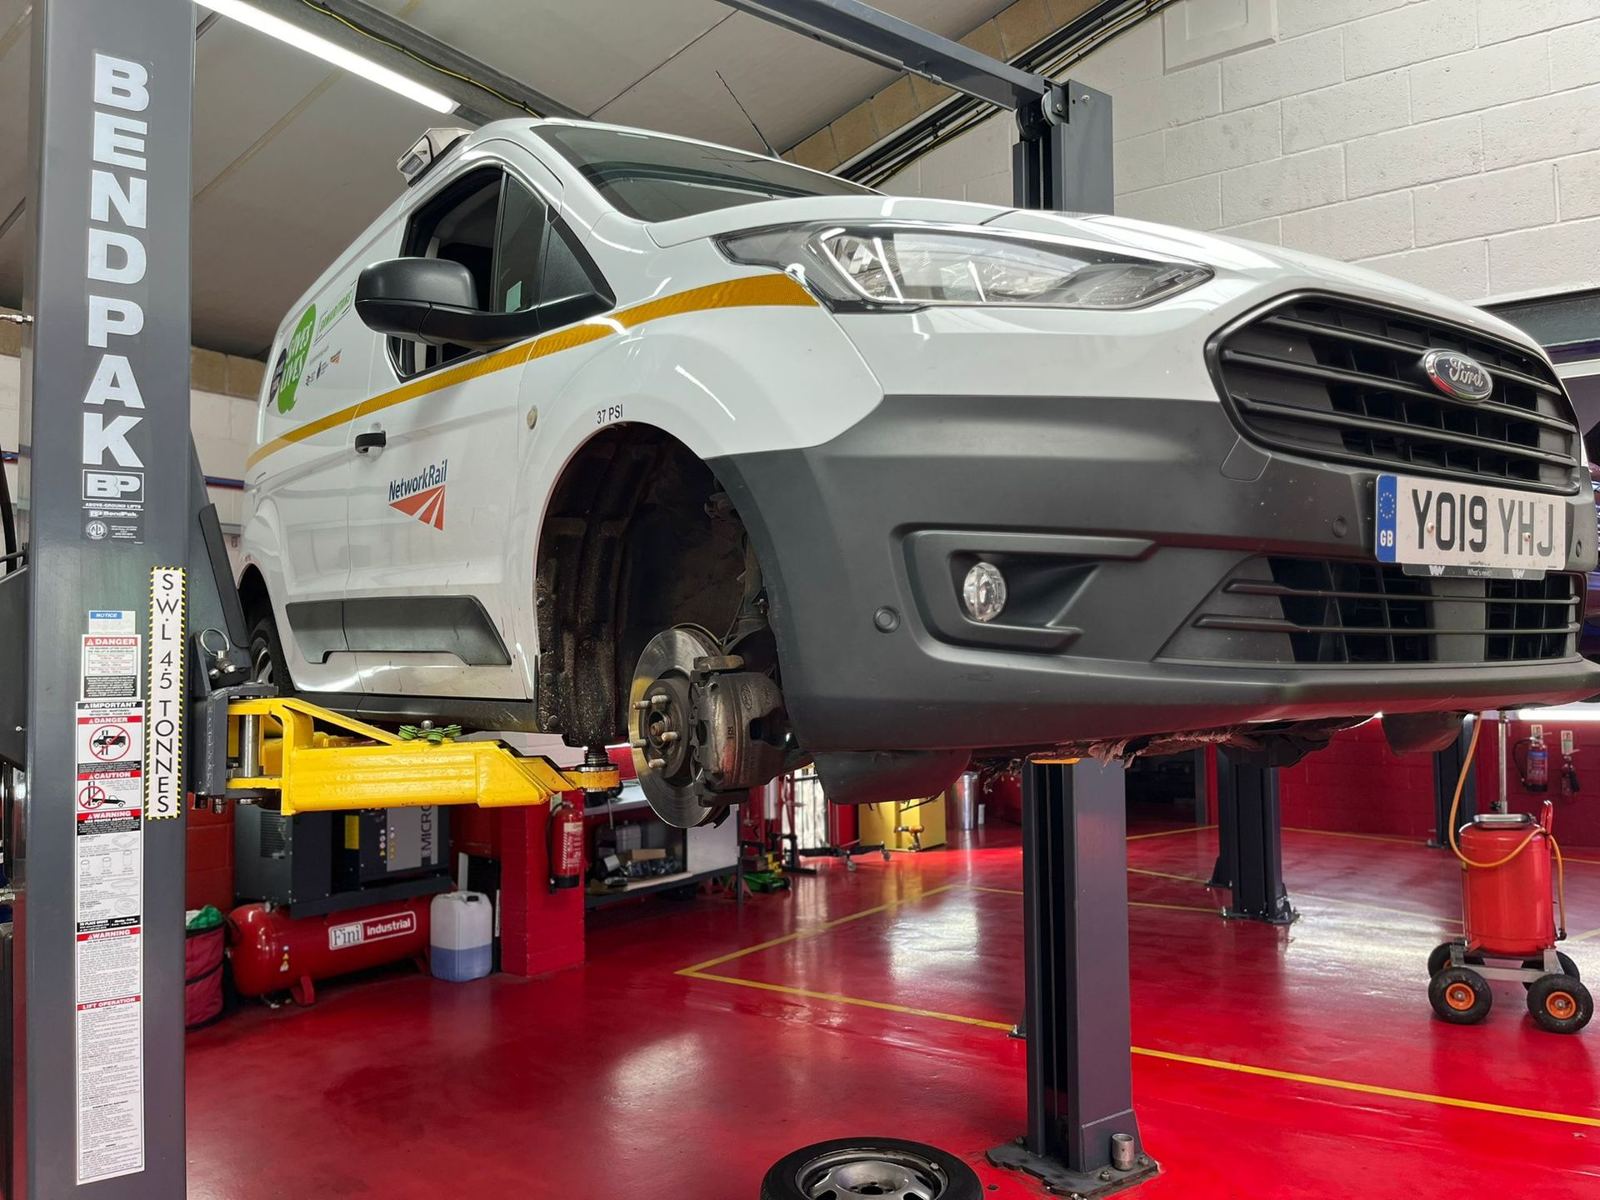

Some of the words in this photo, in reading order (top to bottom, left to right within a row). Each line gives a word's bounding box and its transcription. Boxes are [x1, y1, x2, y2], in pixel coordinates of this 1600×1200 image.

[83, 53, 149, 468] BENDPAK
[1449, 357, 1484, 388] Ford
[596, 409, 606, 424] 37
[608, 404, 623, 421] PSI
[87, 473, 141, 498] BP
[1412, 489, 1487, 553] YO19
[1498, 498, 1553, 556] YHJ
[1380, 530, 1394, 547] GB
[95, 638, 136, 646] DANGER
[159, 651, 174, 690] 4.5
[94, 716, 128, 724] DANGER
[155, 700, 175, 813] TONNES
[94, 810, 132, 819] WARNING
[92, 929, 131, 939] WARNING
[333, 924, 361, 946] Fini
[367, 917, 411, 936] industrial
[83, 1002, 97, 1010] LIFT
[98, 997, 136, 1007] OPERATION
